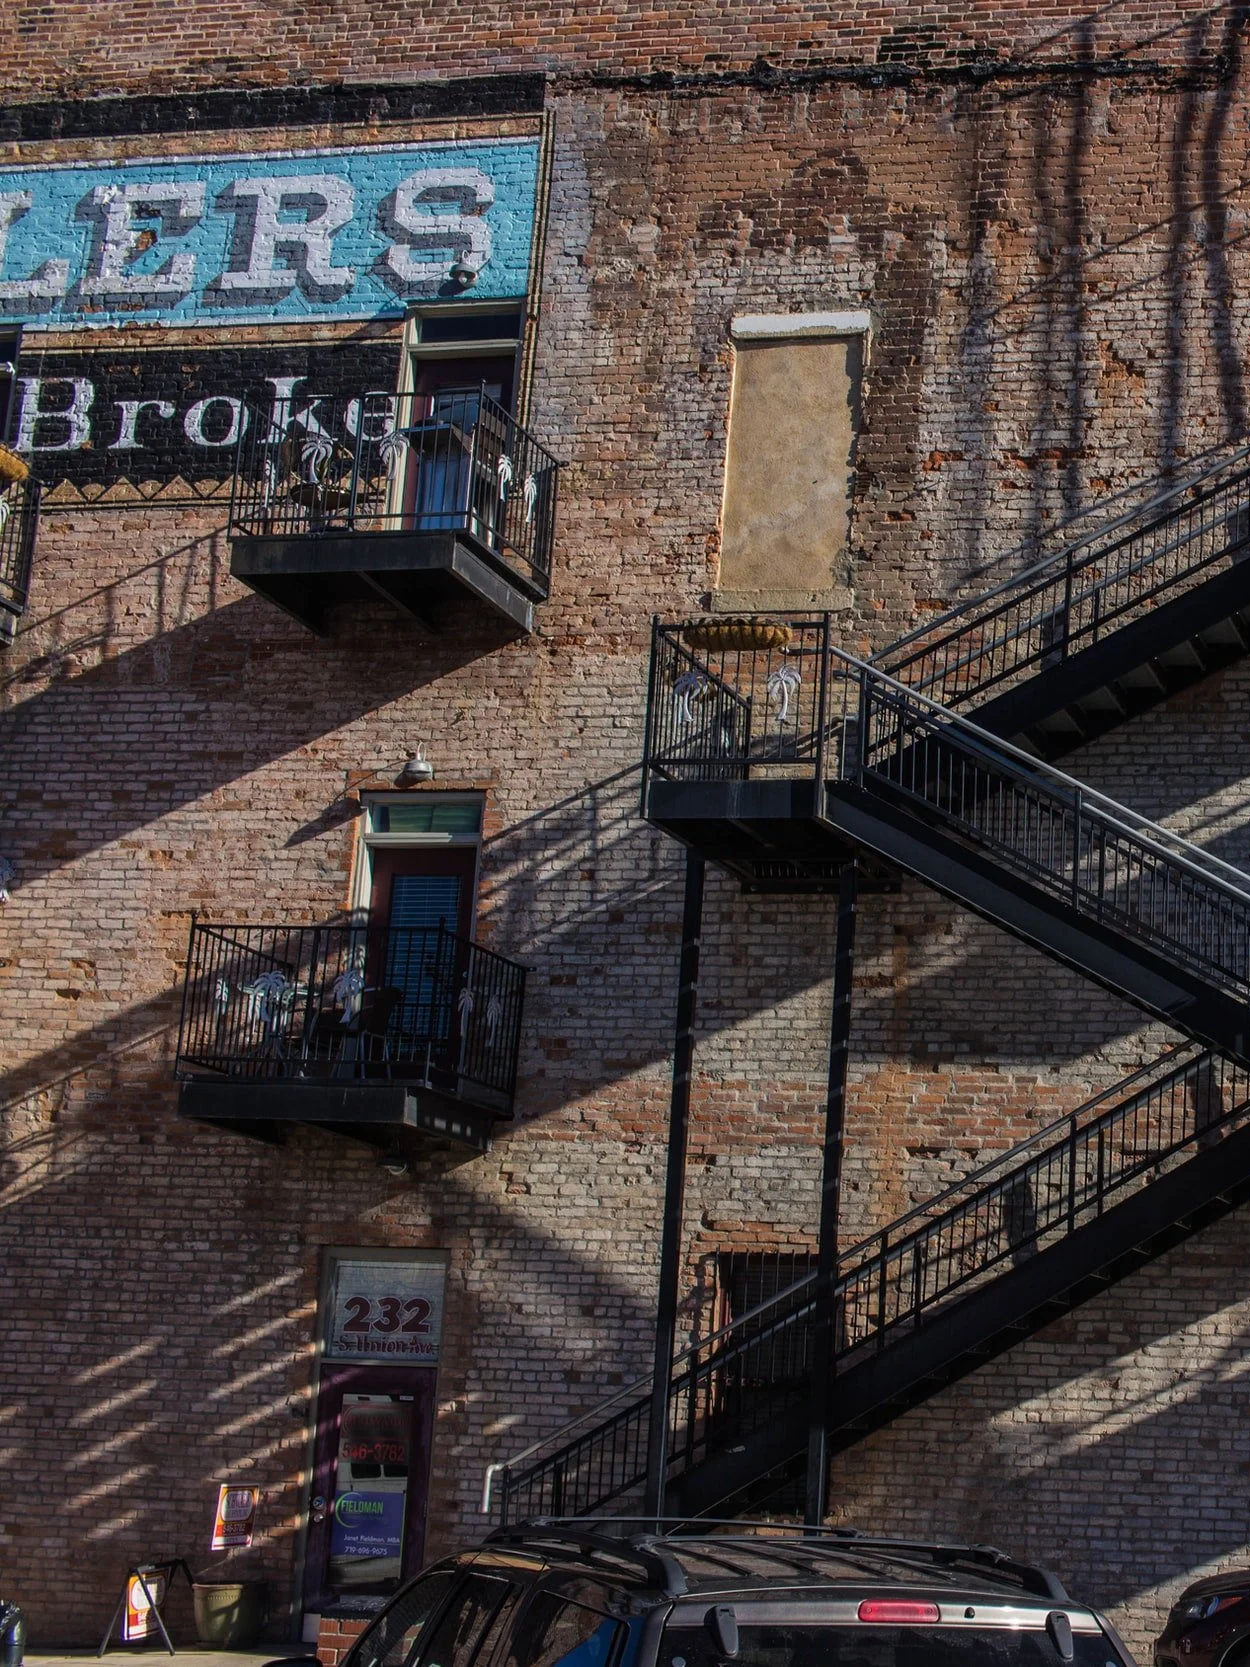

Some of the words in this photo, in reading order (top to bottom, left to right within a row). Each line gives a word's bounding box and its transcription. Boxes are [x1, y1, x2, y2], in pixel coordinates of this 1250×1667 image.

[342, 1295, 432, 1335] 232
[355, 1335, 406, 1353] Union
[341, 1500, 383, 1514] FIELDMAN
